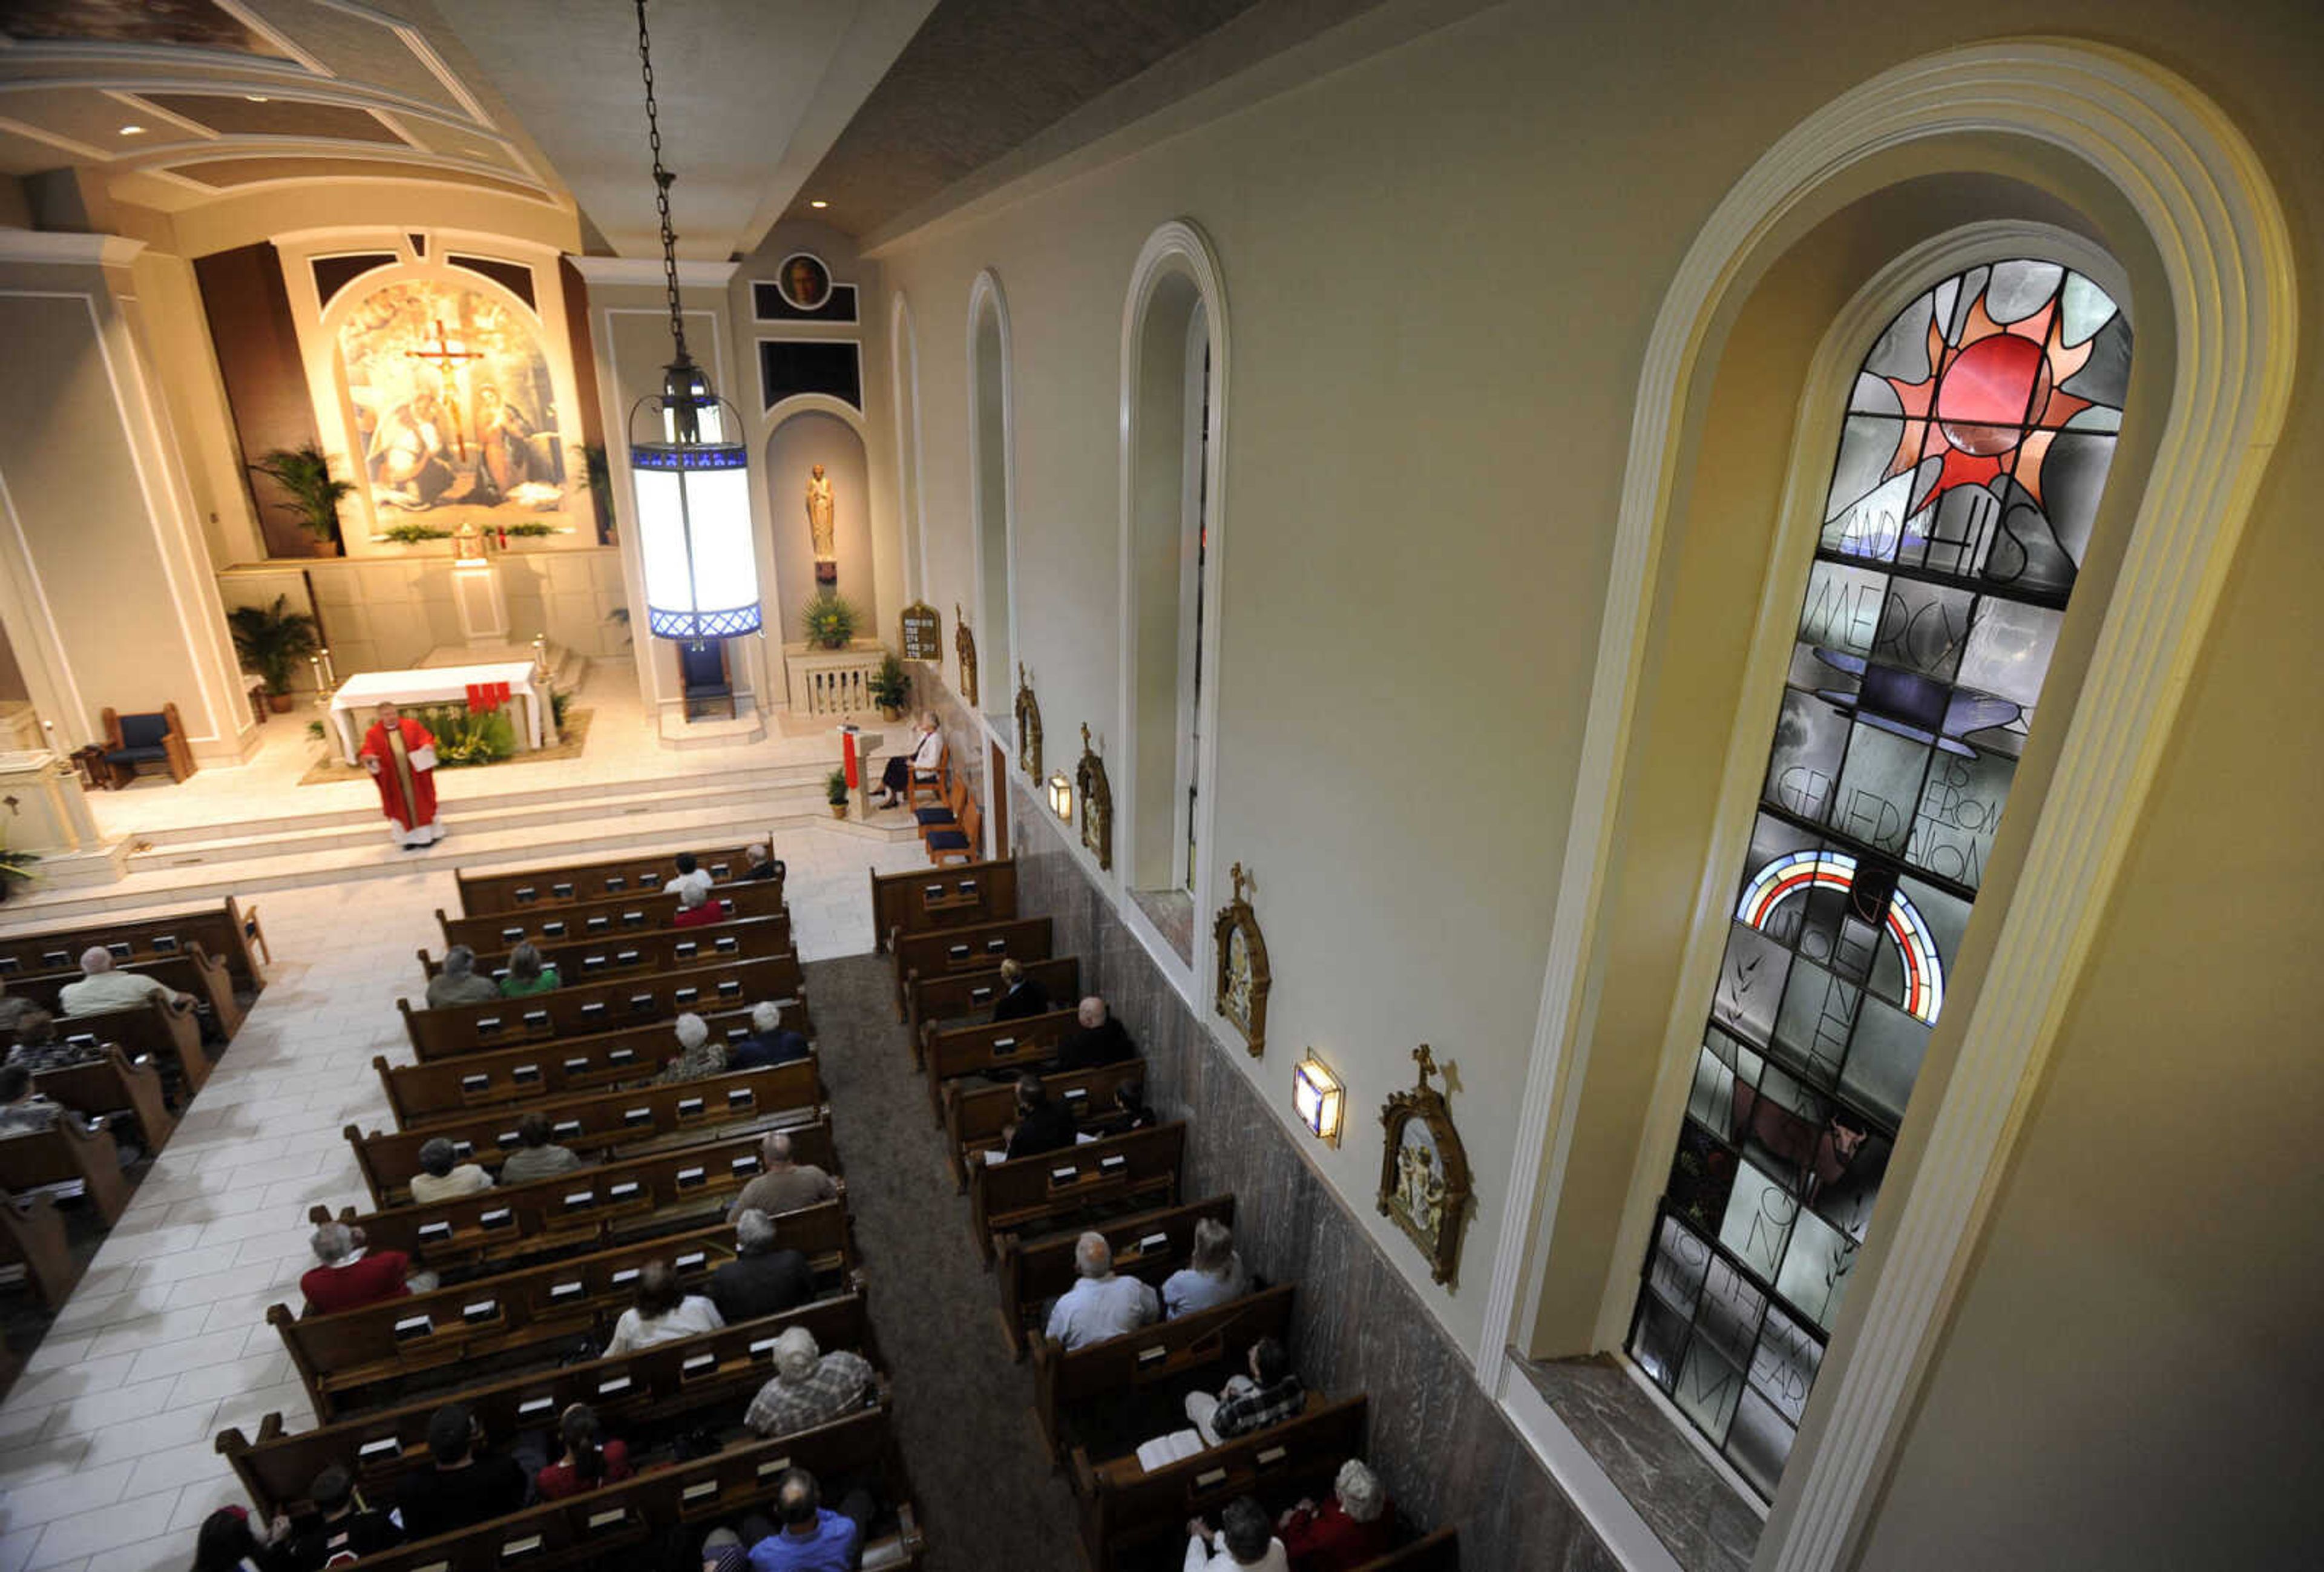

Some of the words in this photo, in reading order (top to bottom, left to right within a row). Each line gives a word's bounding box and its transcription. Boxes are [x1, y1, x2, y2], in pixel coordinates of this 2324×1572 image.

[1837, 509, 1897, 559] AND
[1922, 488, 2038, 584] HIS
[1802, 579, 1986, 672] MERCY
[1778, 766, 1980, 887] GENERATION
[1924, 780, 2002, 835] FROM
[1716, 1258, 1814, 1375] THEM
